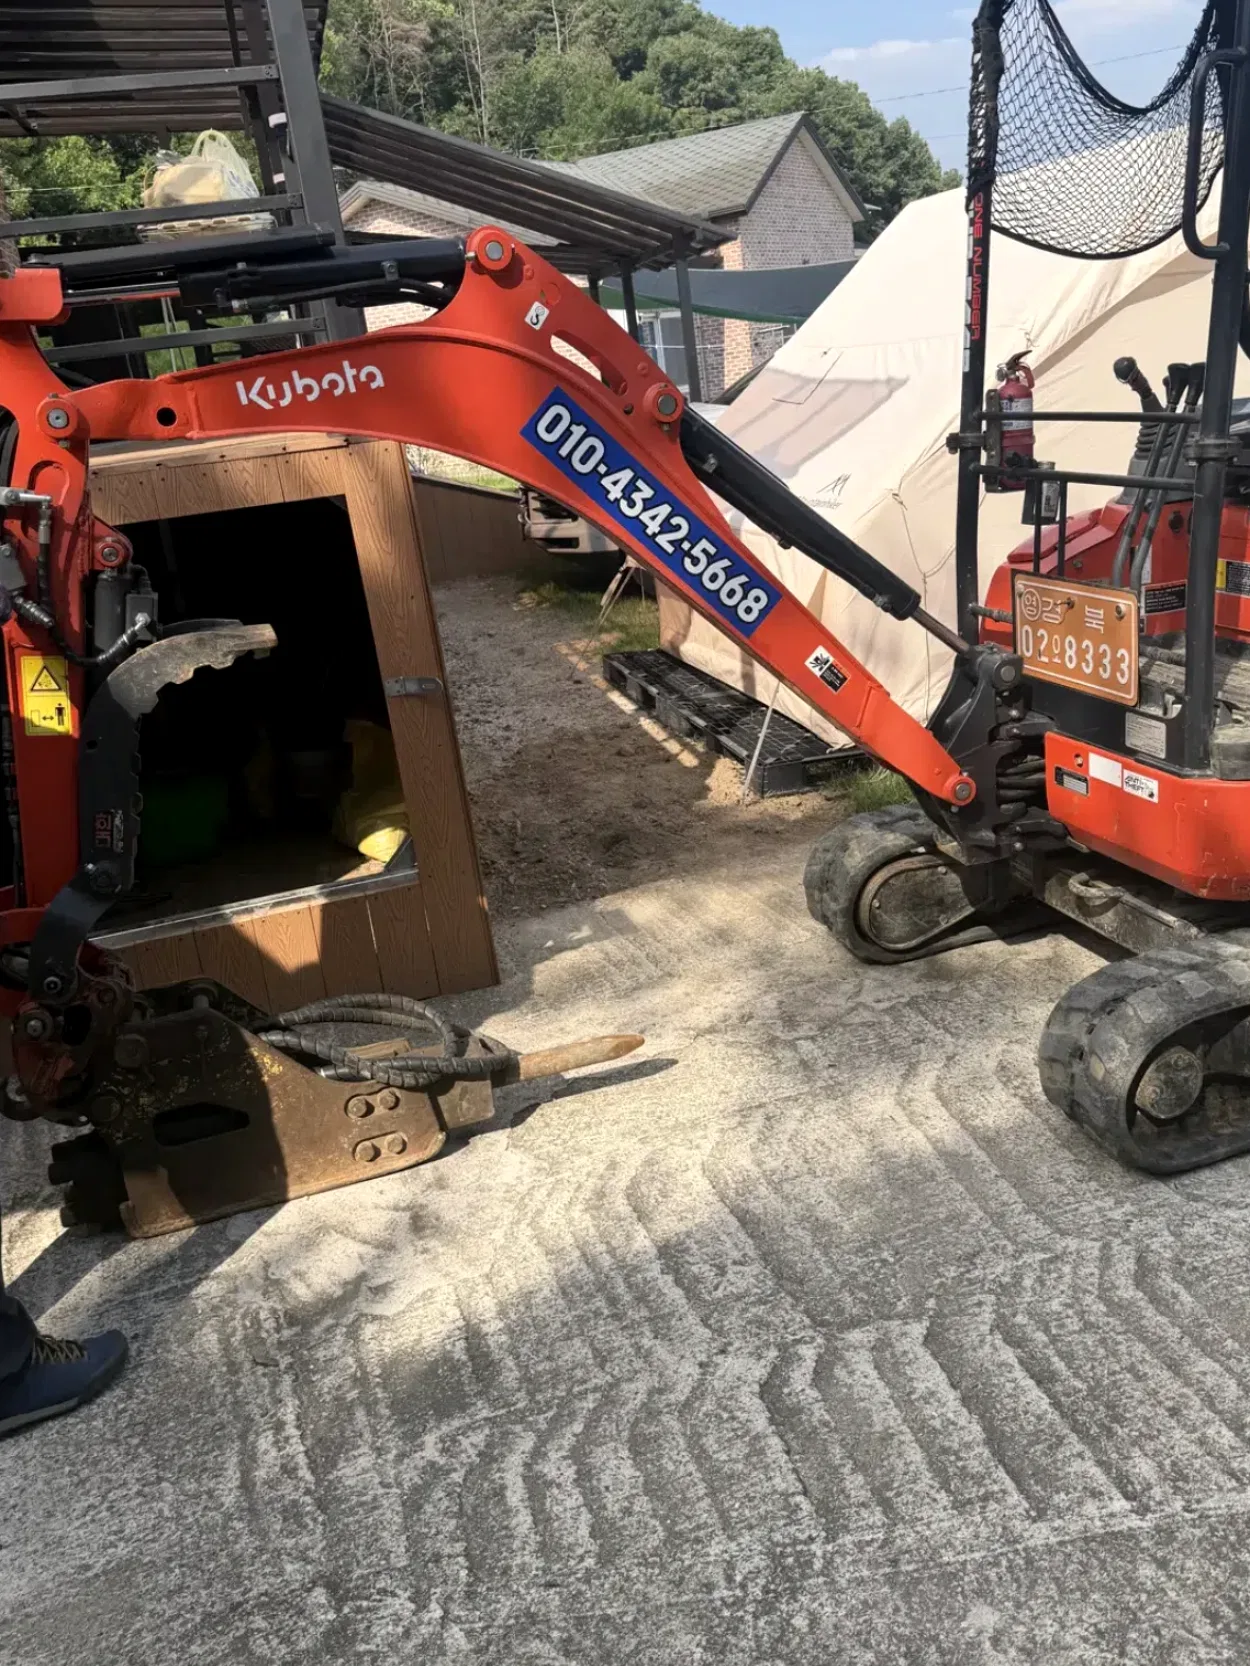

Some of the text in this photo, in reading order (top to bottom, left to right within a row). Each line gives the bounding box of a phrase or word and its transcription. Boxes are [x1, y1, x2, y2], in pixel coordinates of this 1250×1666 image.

[971, 247, 982, 340] NUMBER
[235, 360, 385, 410] Kubota
[536, 404, 768, 623] 010-4342-5668
